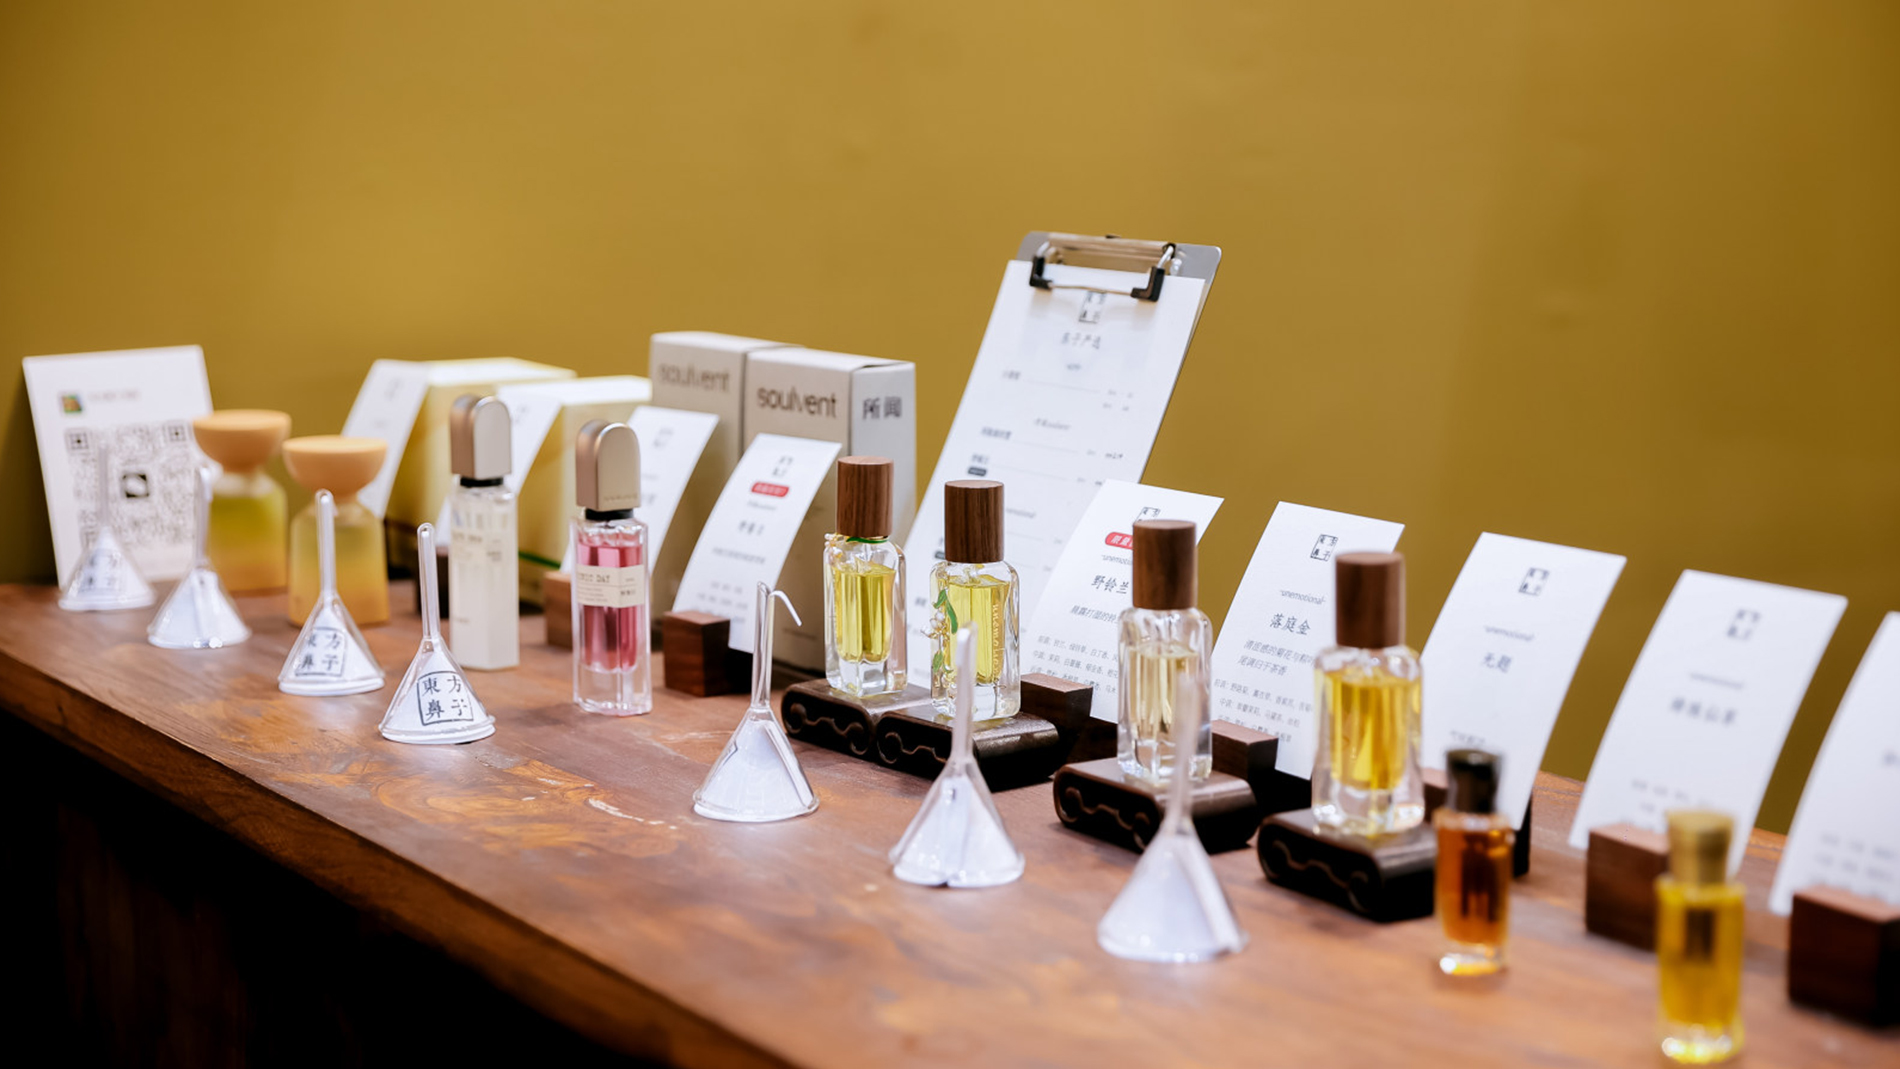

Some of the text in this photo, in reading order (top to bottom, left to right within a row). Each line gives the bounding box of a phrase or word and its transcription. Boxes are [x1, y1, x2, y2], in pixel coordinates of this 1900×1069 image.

[659, 363, 731, 393] soulvent
[757, 385, 837, 419] soulvent
[862, 396, 903, 420] 所闻
[1091, 574, 1129, 594] 野铃兰
[1269, 613, 1311, 635] 落庭金
[421, 676, 462, 696] 東方
[424, 698, 469, 721] 鼻子
